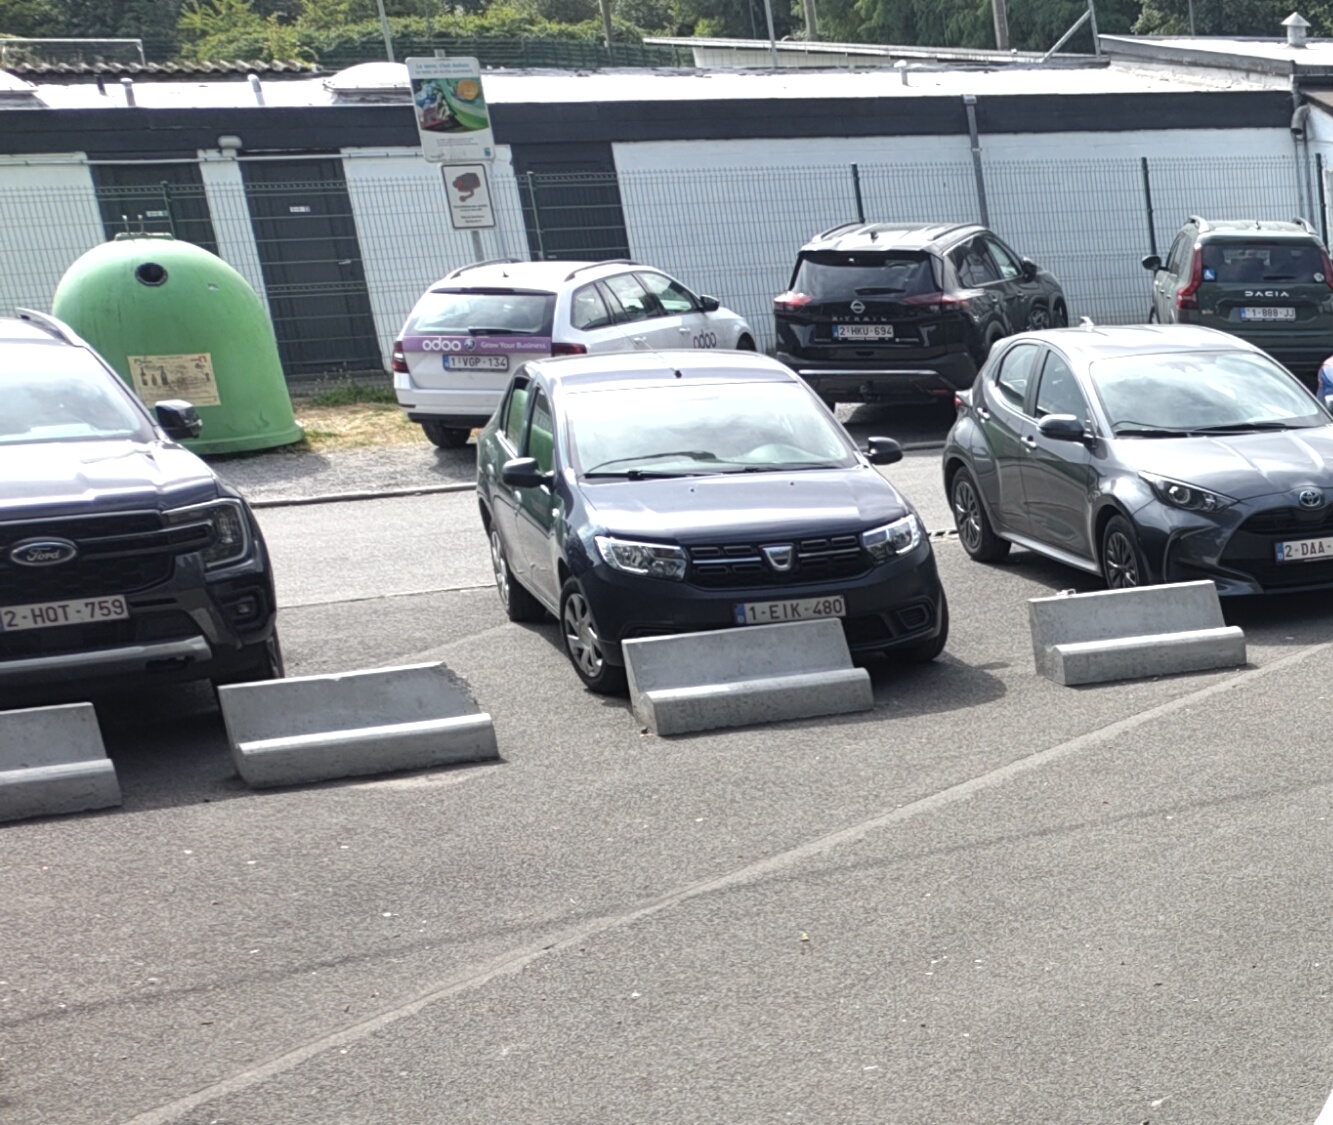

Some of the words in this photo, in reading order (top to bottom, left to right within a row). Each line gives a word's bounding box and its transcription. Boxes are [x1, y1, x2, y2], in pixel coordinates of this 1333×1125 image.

[422, 337, 462, 351] odoo
[26, 547, 61, 561] Ford
[748, 598, 843, 621] 1-EIK-480
